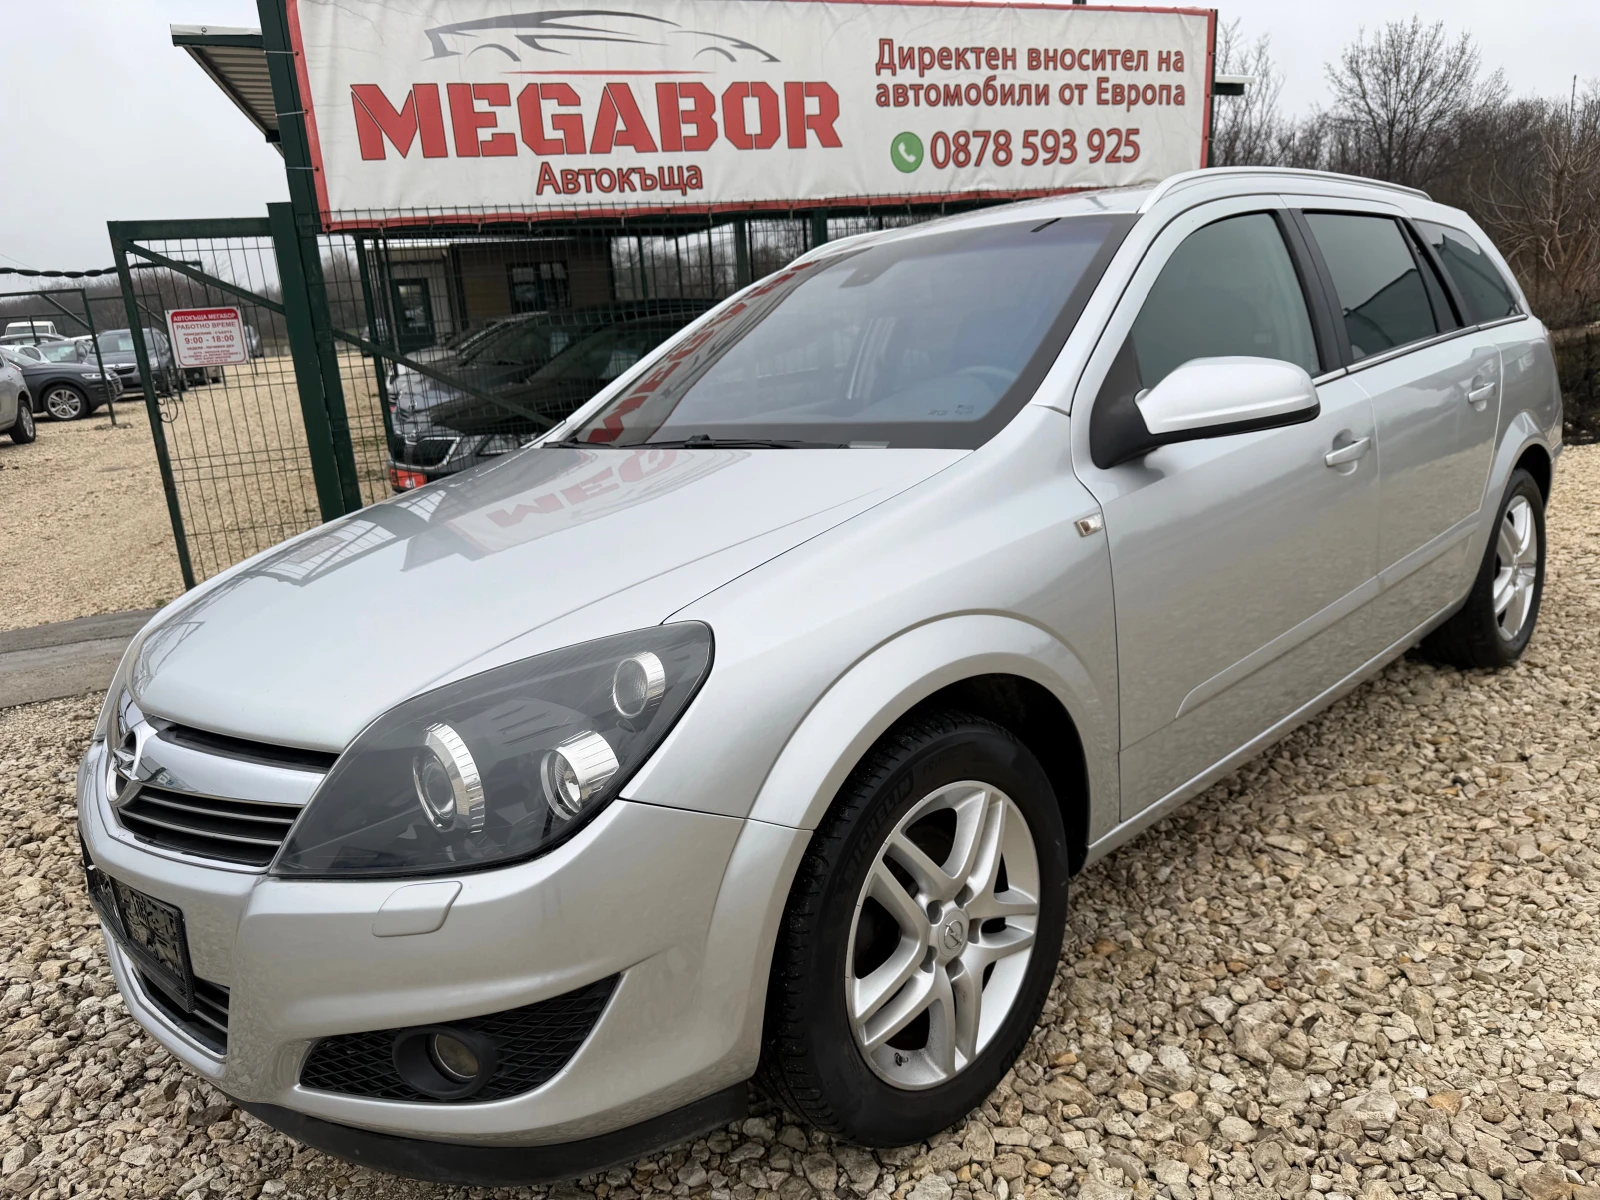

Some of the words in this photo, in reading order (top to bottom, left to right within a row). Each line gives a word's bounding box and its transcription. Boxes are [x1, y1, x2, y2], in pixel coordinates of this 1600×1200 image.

[875, 38, 1017, 77] Директен
[1027, 48, 1148, 72] вносител
[1157, 50, 1185, 72] на
[875, 75, 1050, 107] автомобили
[1059, 83, 1088, 106] от
[1097, 77, 1186, 112] Европа
[350, 82, 843, 161] MEGABOR
[930, 130, 1013, 170] 0878
[1021, 129, 1078, 166] 593
[1087, 128, 1140, 164] 925
[536, 162, 704, 196] Автокъща
[176, 322, 210, 330] РАБОТНО
[184, 337, 203, 345] 9:00
[211, 335, 235, 343] 18:00
